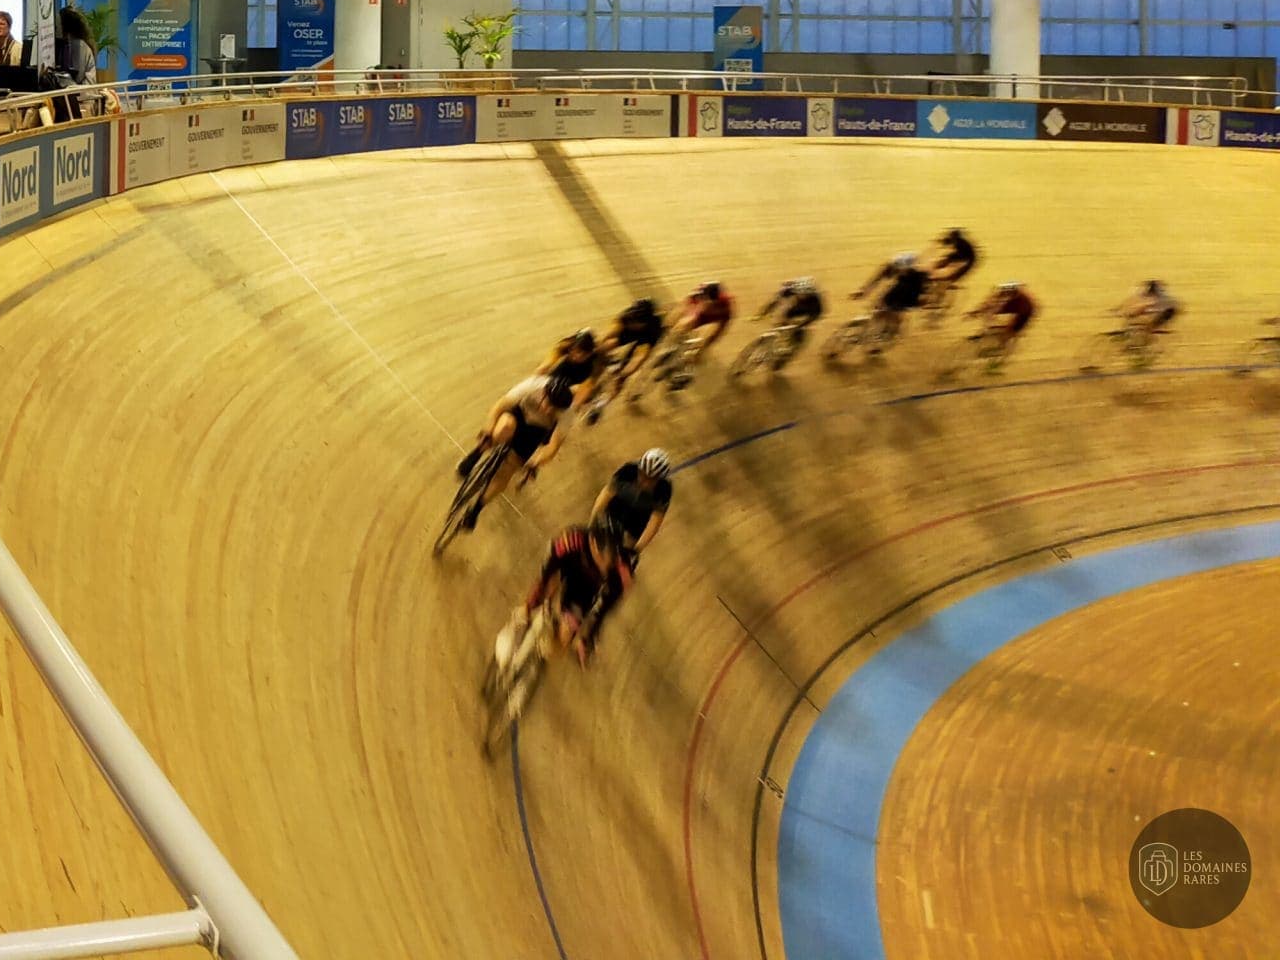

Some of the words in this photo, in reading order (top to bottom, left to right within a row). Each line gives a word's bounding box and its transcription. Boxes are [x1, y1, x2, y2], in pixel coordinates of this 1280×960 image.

[293, 29, 324, 39] OSER
[718, 25, 753, 36] STAB
[292, 108, 317, 128] STAB
[339, 105, 365, 124] STAB
[388, 103, 415, 121] STAB
[438, 101, 465, 118] STAB
[56, 136, 91, 186] Nord
[1, 151, 37, 207] Nord
